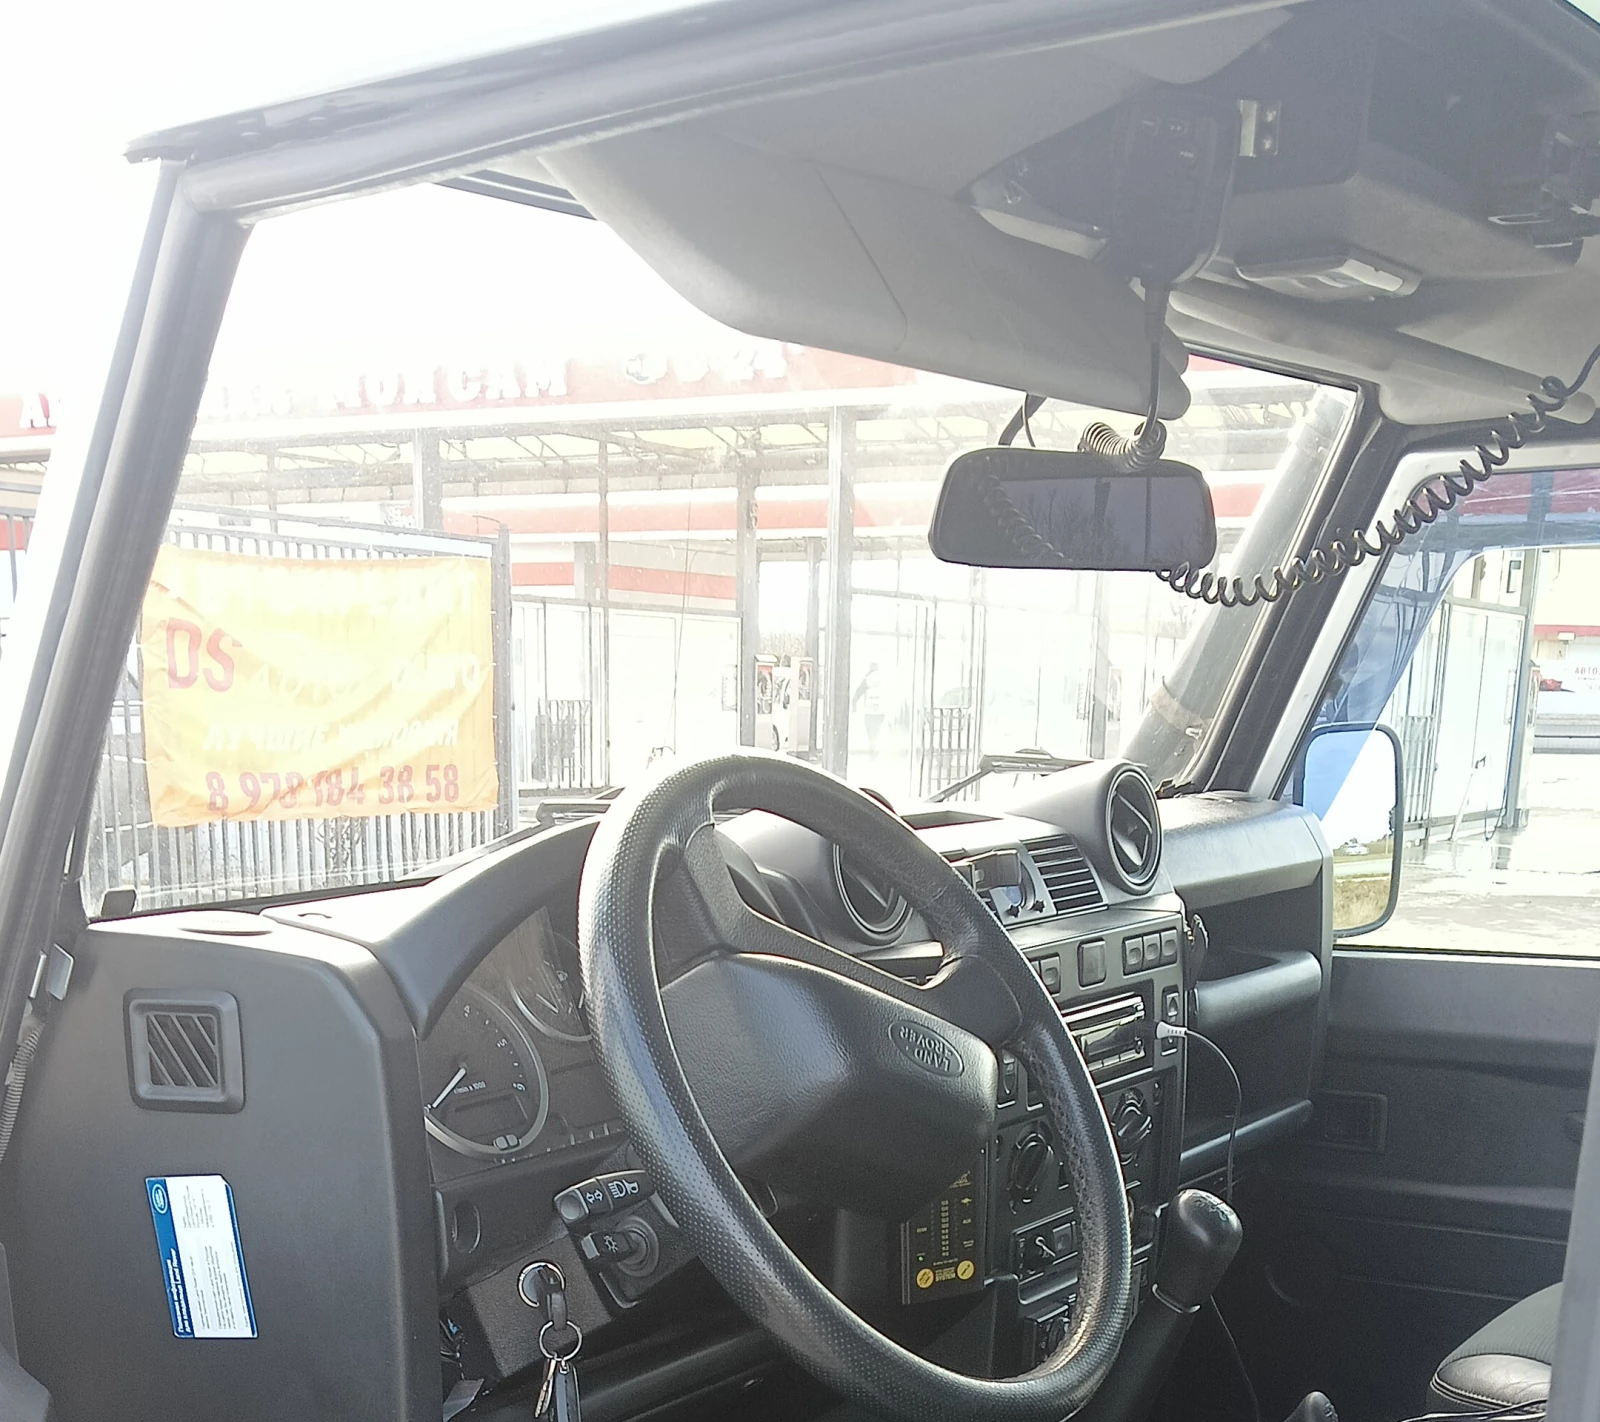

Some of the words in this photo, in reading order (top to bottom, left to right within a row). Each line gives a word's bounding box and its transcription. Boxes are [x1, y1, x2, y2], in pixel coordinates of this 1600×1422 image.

[165, 617, 243, 692] DS
[205, 771, 229, 811] 8
[240, 771, 304, 810] 978
[379, 764, 413, 804] 38
[425, 764, 459, 803] 58
[899, 1026, 943, 1052] ROVER
[914, 1049, 950, 1072] LAND
